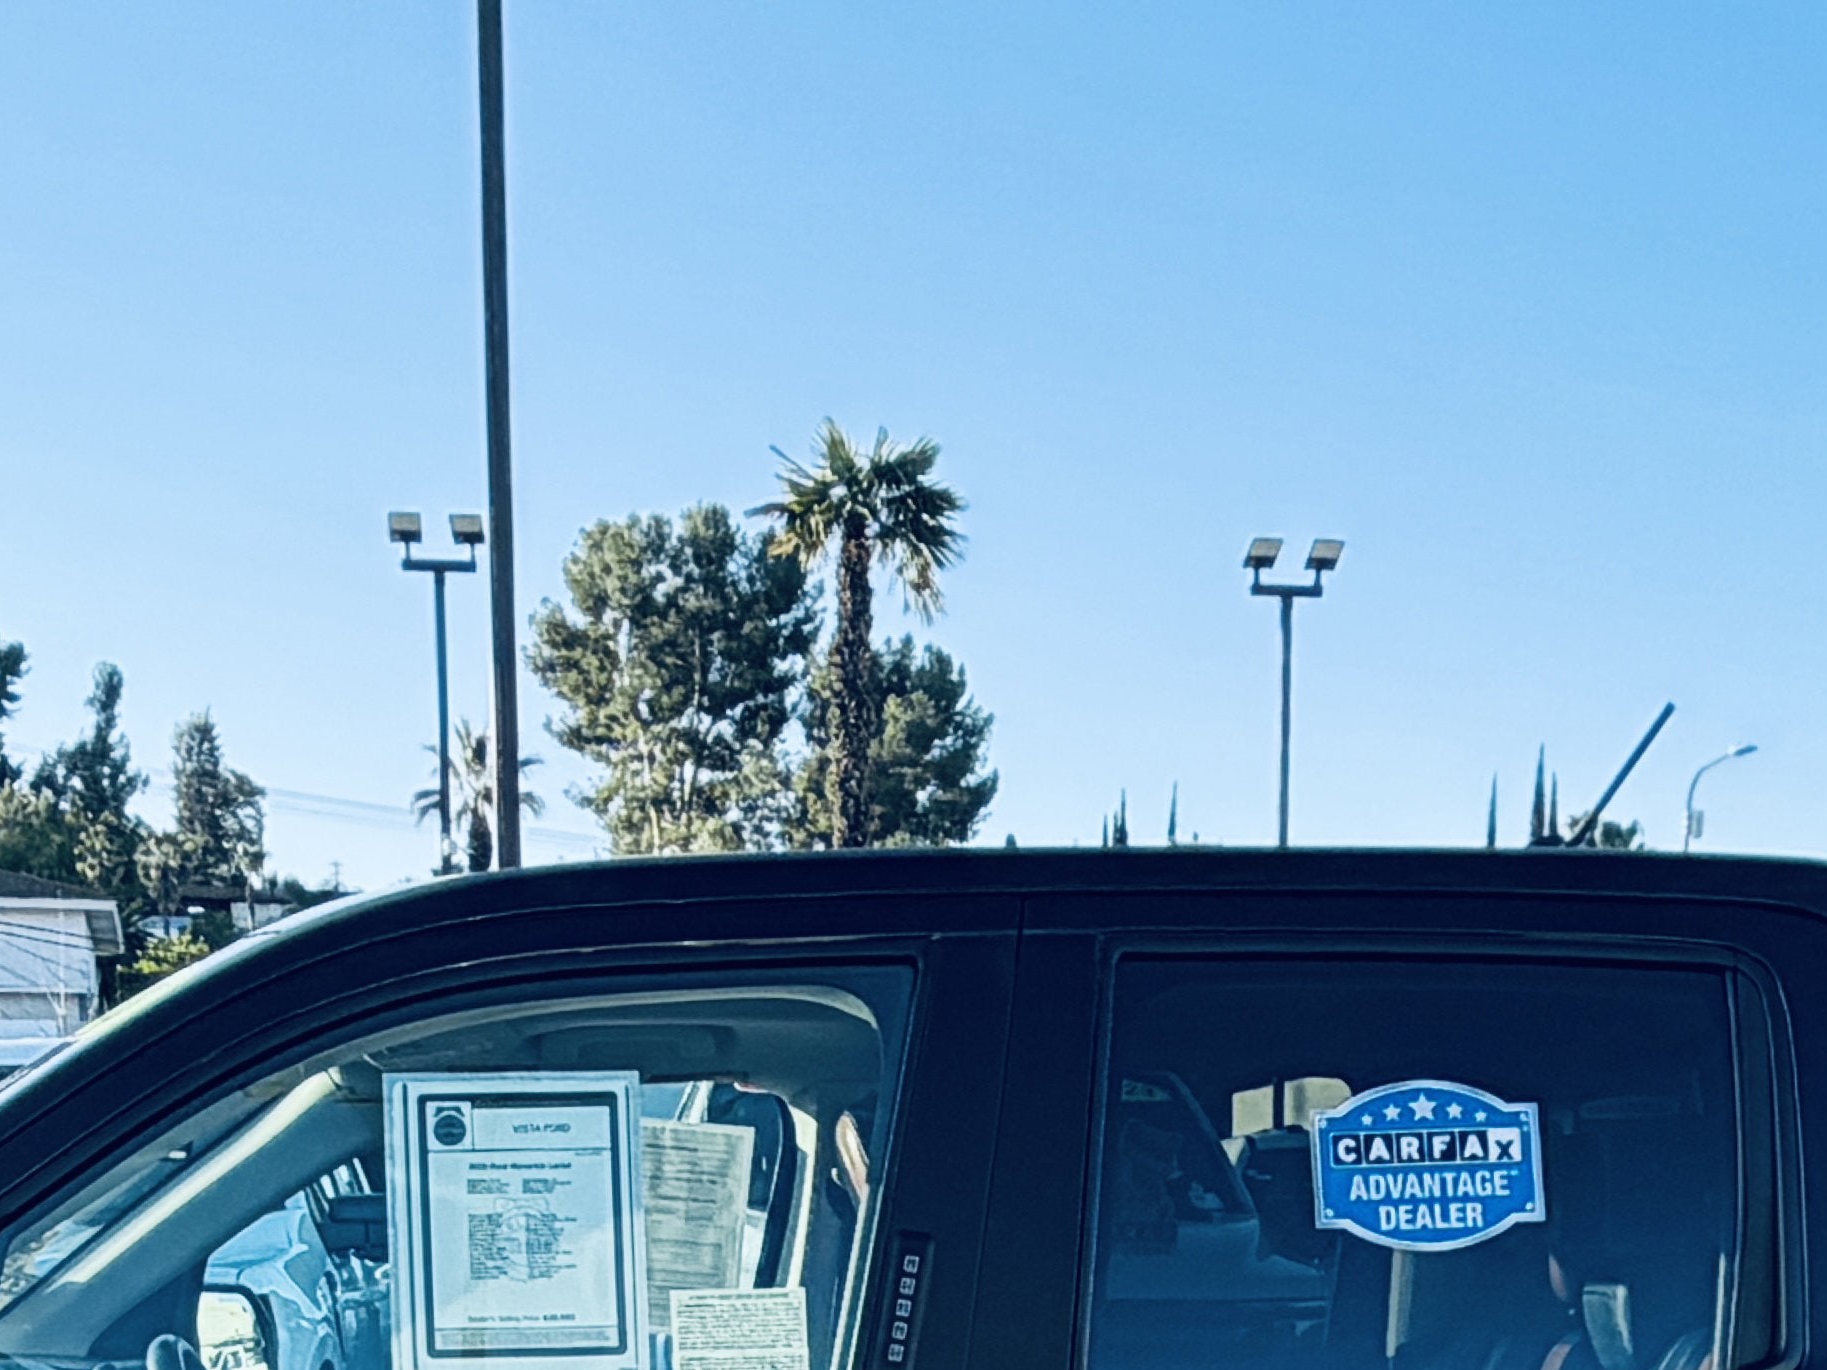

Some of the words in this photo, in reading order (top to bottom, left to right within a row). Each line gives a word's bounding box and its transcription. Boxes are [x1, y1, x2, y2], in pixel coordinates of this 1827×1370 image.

[1337, 1134, 1515, 1163] CARFAX
[1349, 1170, 1511, 1201] ADVANTAGE
[1379, 1202, 1484, 1230] DEALER
